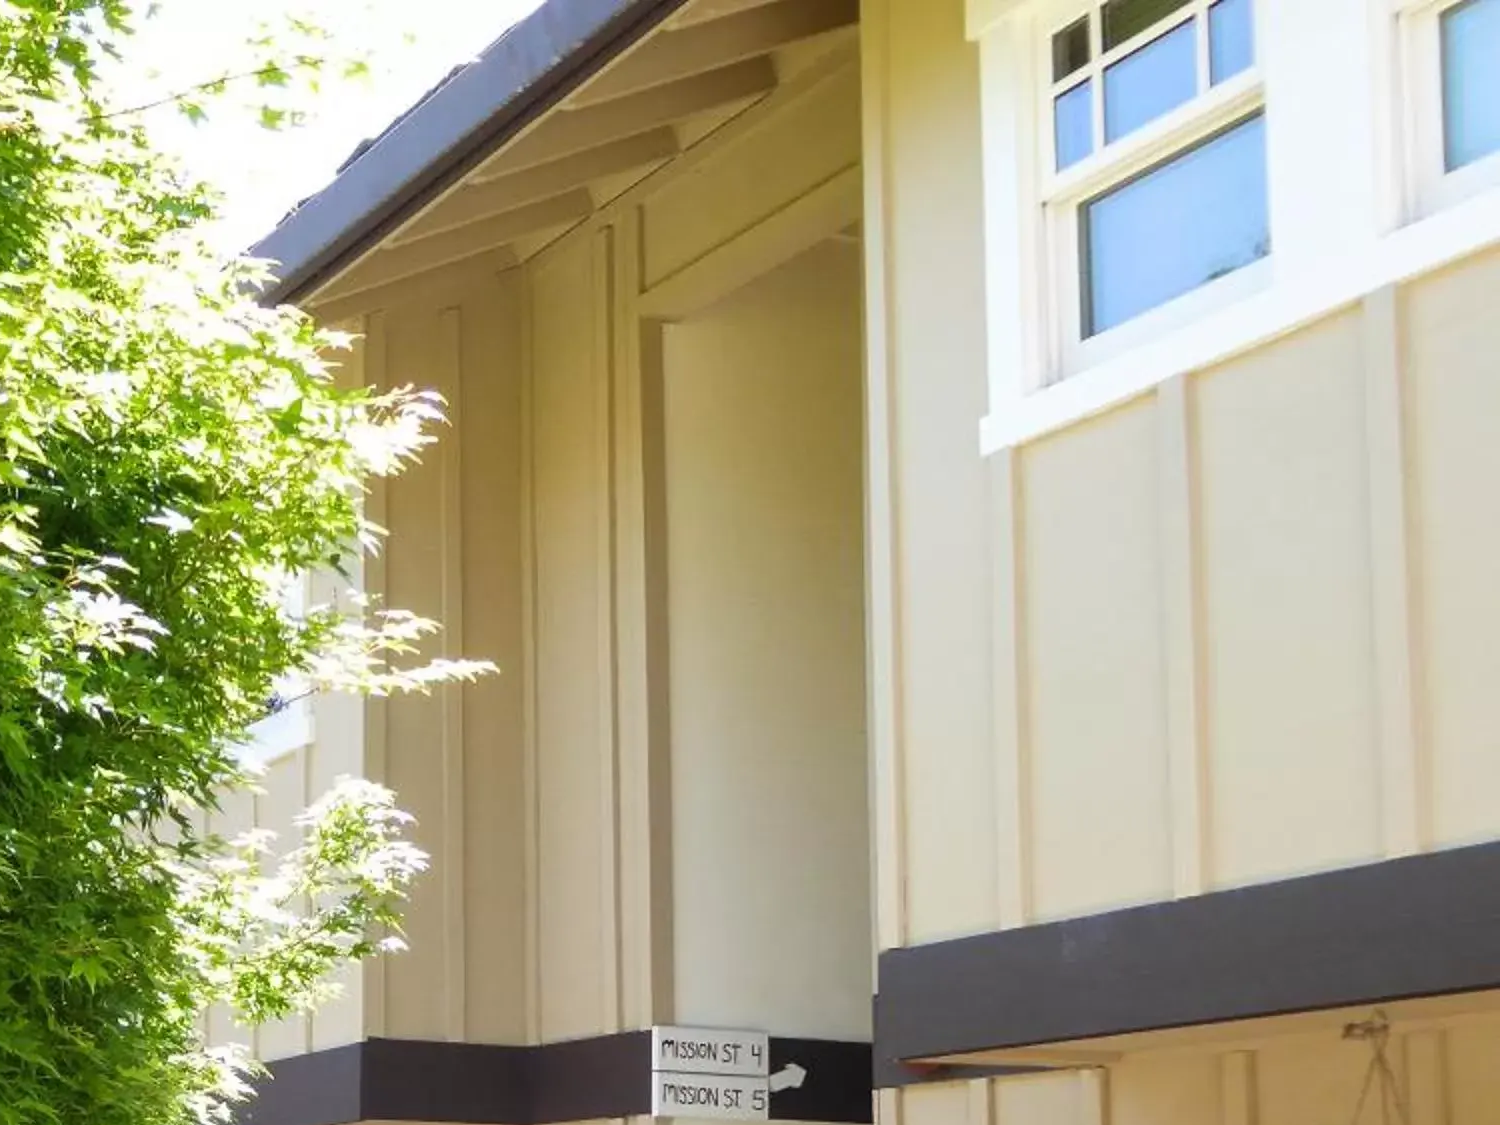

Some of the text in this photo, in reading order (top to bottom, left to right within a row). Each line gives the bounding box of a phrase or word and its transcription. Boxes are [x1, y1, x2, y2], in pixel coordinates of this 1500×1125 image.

[661, 1039, 762, 1067] MISSION ST 4
[662, 1083, 767, 1111] MISSION ST 5
